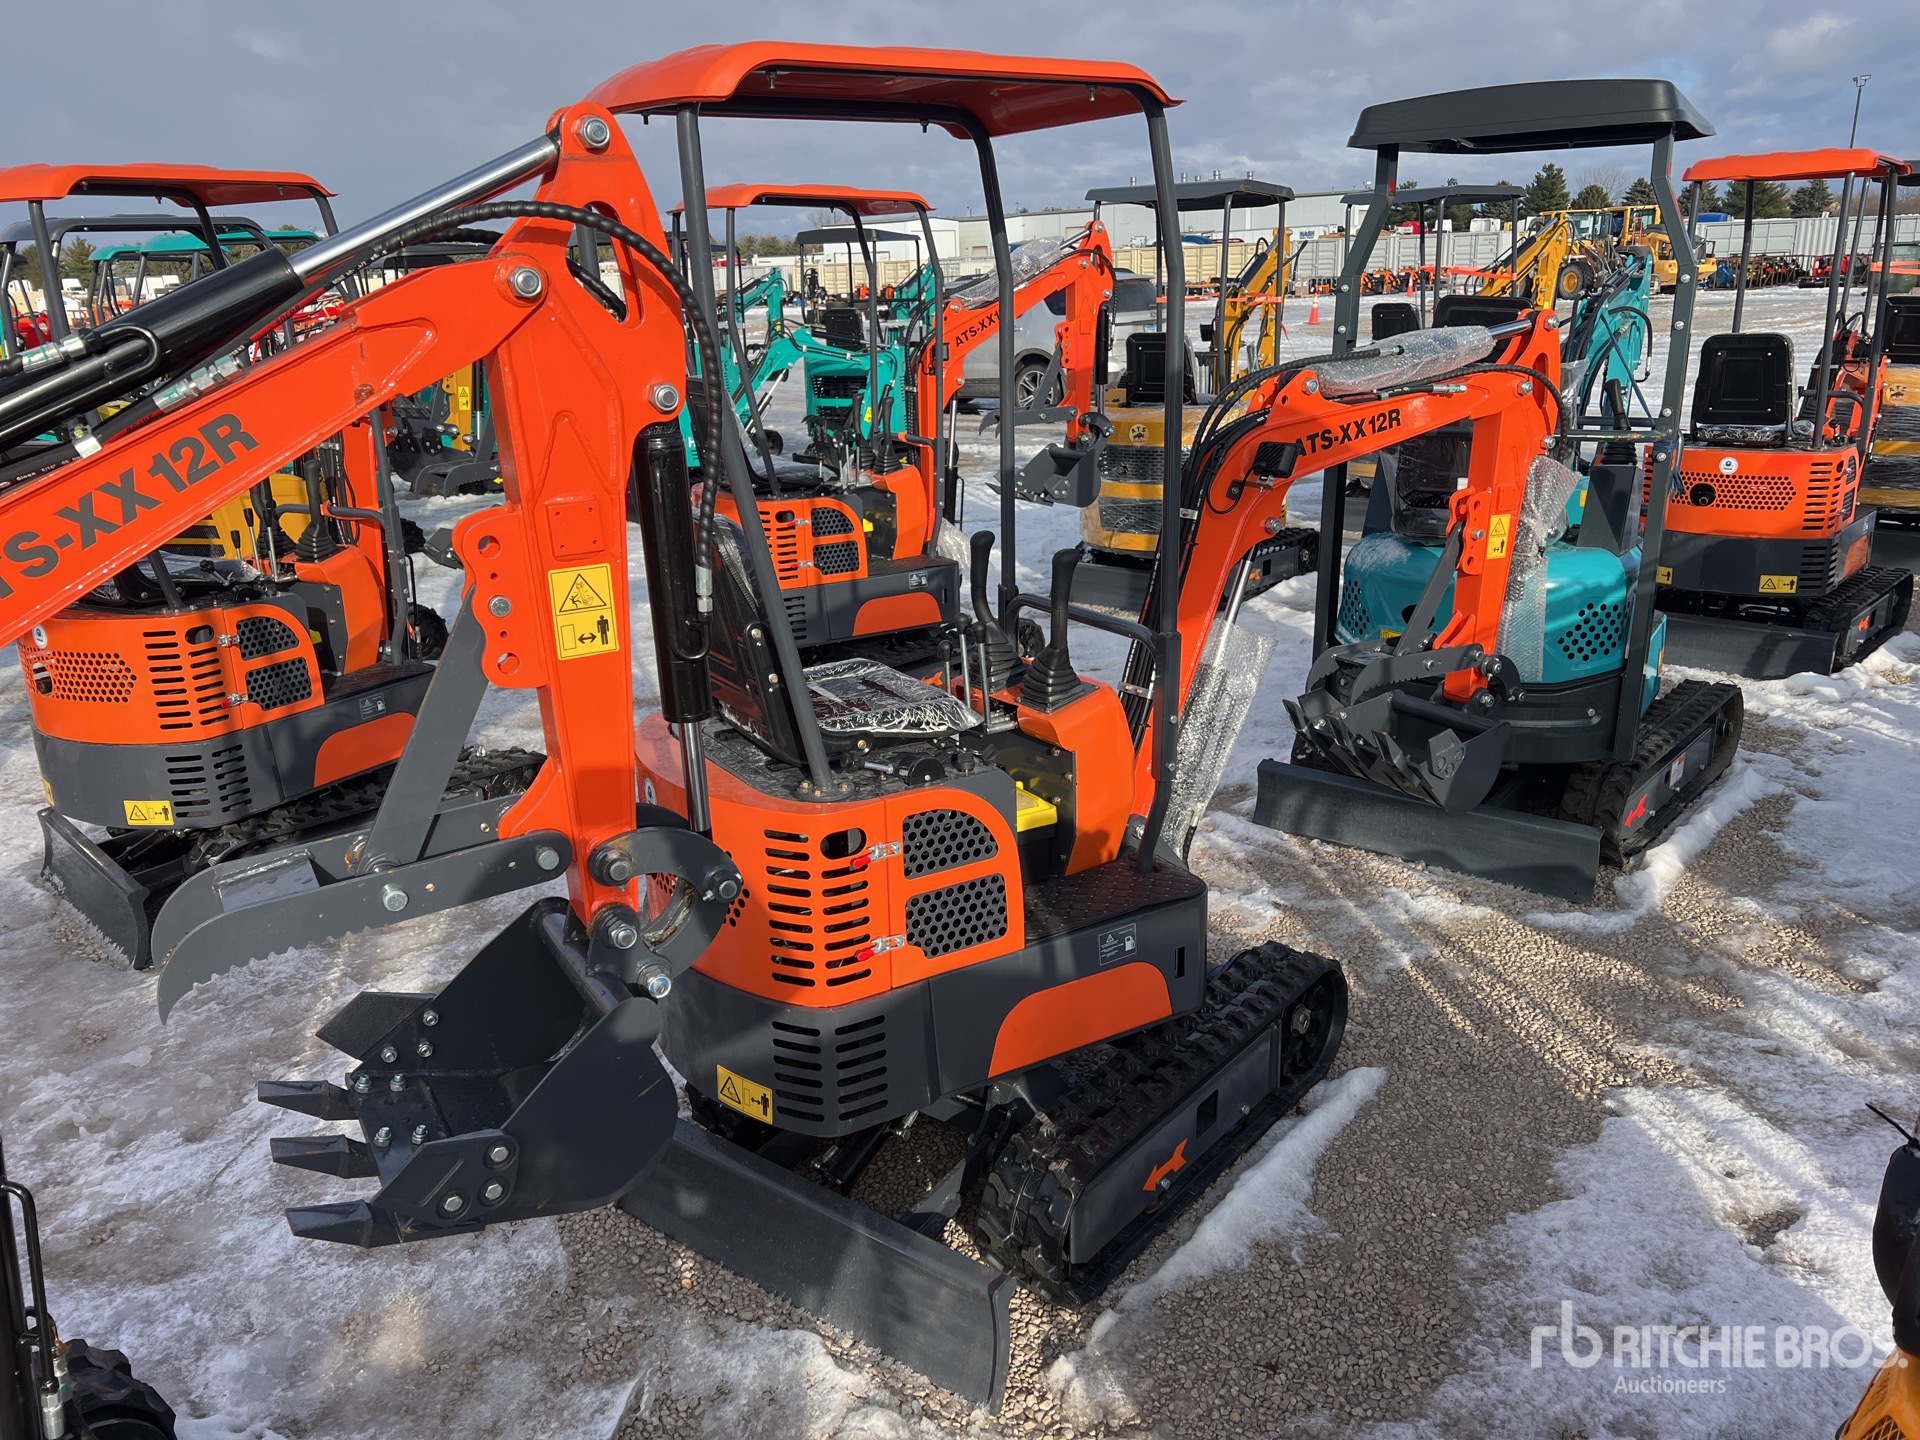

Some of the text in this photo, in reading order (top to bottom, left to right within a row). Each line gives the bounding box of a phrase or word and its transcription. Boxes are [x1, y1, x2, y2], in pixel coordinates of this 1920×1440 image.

[1299, 230, 1315, 238] NASH
[1131, 426, 1147, 434] ATS
[147, 413, 260, 494] 12R
